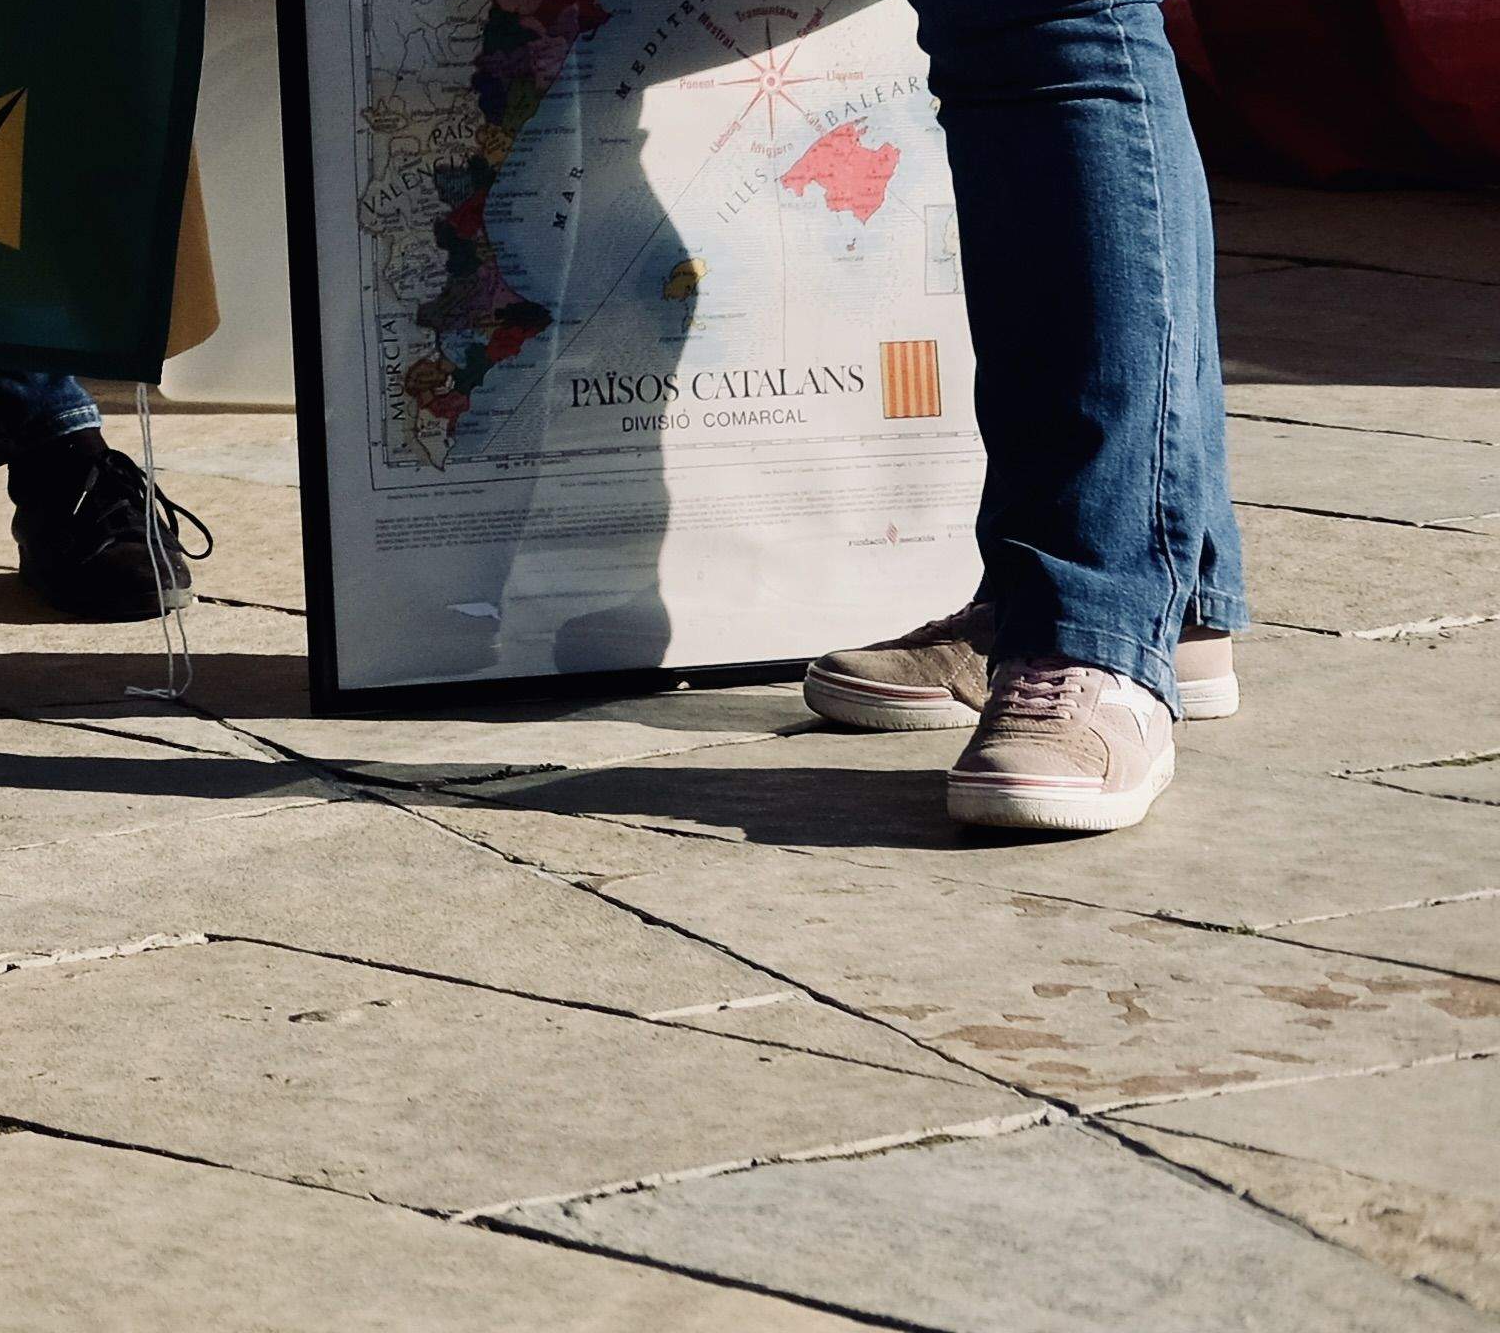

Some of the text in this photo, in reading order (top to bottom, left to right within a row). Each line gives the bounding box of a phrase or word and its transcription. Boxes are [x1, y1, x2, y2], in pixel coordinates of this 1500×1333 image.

[716, 75, 928, 224] ILLES BALEAR
[553, 166, 585, 230] MAR
[570, 364, 865, 408] PAÏSOS CATALANS
[621, 408, 808, 432] DIVISIÓ COMARCAL
